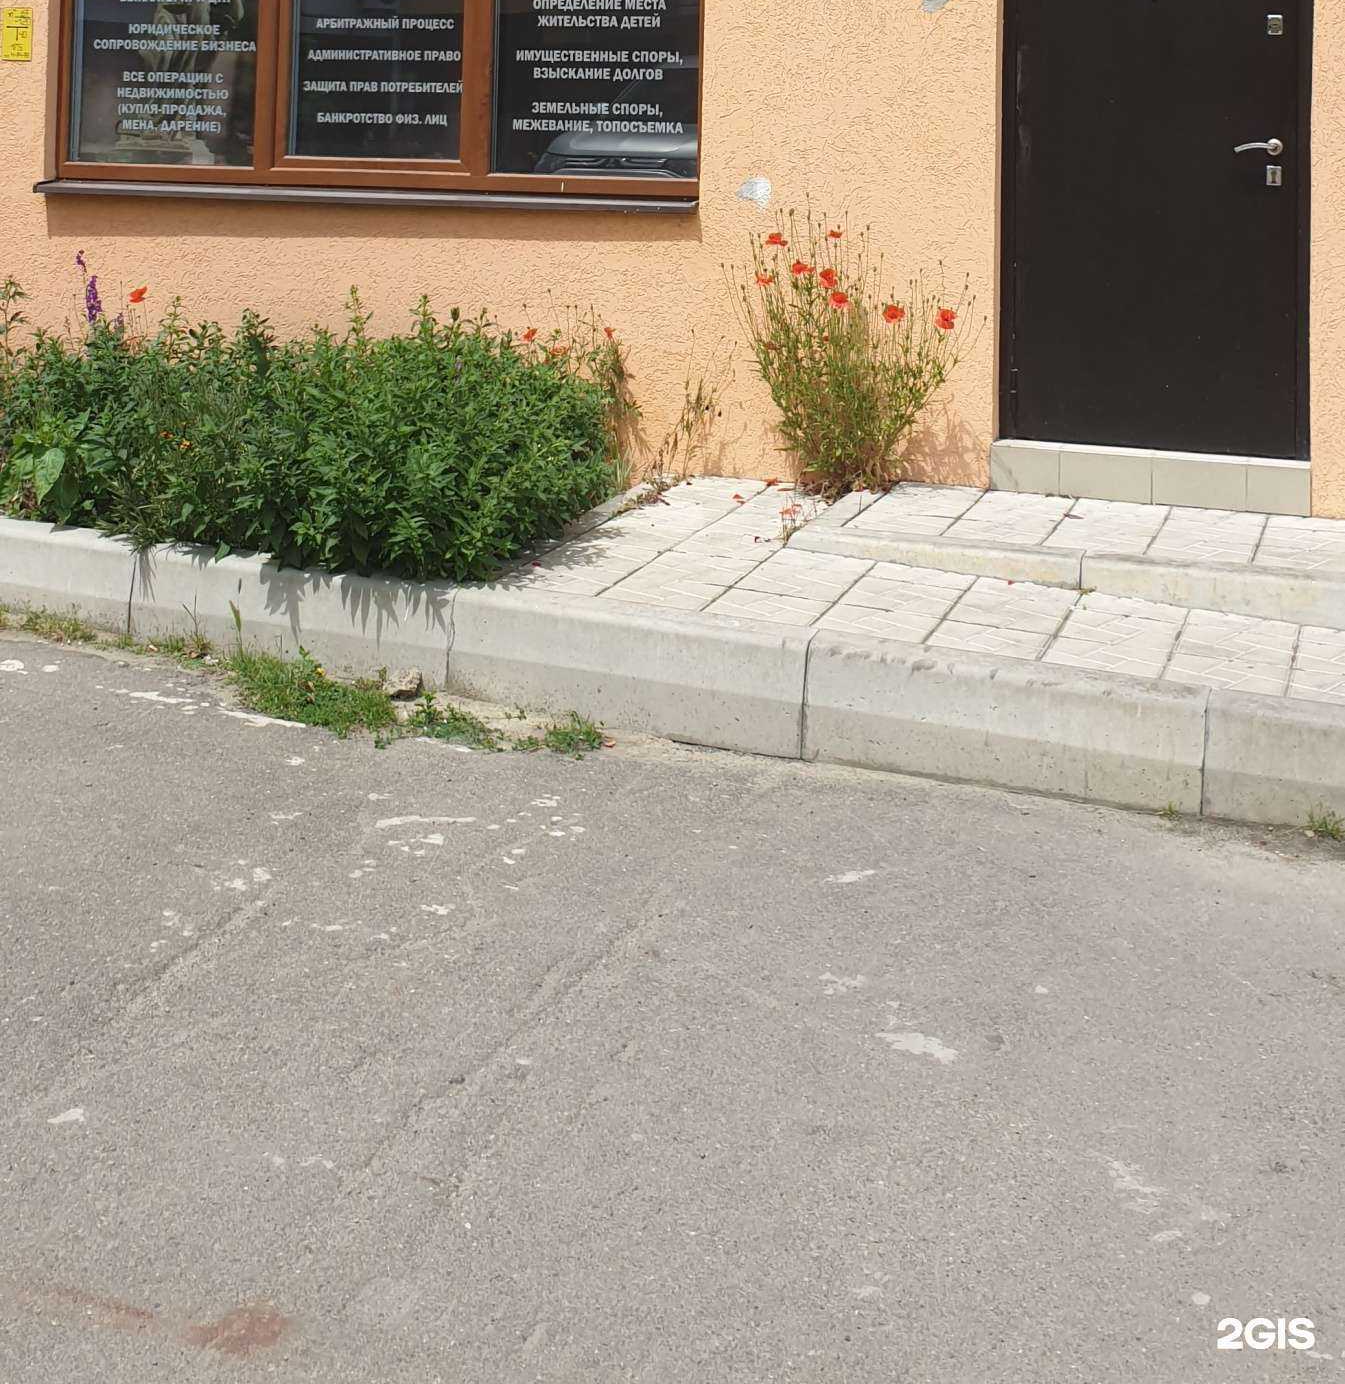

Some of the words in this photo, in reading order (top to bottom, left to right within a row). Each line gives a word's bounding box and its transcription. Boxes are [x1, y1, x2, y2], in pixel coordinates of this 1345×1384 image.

[316, 16, 399, 29] АРБИТРАЖНЫЙ
[402, 19, 454, 31] ПРОЦЕСС
[538, 16, 618, 27] ЖИТЕЛЬСТВА
[621, 13, 661, 29] ДЕТЕЙ
[128, 24, 220, 36] ЮРИДИЧЕСКОЕ
[94, 40, 198, 51] СОПРОВОЖДЕНИЕ
[201, 41, 256, 52] БИЗНЕСА
[308, 50, 421, 61] АДМИНИСТРАТИВНОЕ
[424, 51, 461, 61] ПРАВО
[516, 50, 629, 63] ИМУЩЕСТВЕННЫЕ
[632, 51, 683, 65] СПОРЫ,
[123, 72, 144, 82] ВСЕ
[148, 72, 212, 83] ОПЕРАЦИИ
[215, 73, 224, 83] С
[534, 68, 610, 79] ВЗЫСКАНИЕ
[613, 69, 663, 81] ДОЛГОВ
[304, 81, 347, 93] ЗАЩИТА
[350, 82, 377, 92] ПРАВ
[381, 80, 464, 93] ПОТРЕБИТЕЛЕЙ
[117, 88, 228, 99] НЕДВИЖИМОСТЬЮ
[532, 102, 609, 114] ЗЕМЕЛЬНЫЕ
[612, 104, 663, 117] СПОРЫ,
[317, 113, 392, 124] БАНКРОТСТВО
[396, 114, 422, 124] ФИЗ.
[425, 115, 448, 126] ЛИЦ
[161, 120, 222, 133] ДАРЕНИЕ)
[513, 119, 594, 133] МЕЖЕВАНИЕ,
[596, 120, 683, 134] ТОПОСЪЕМКА
